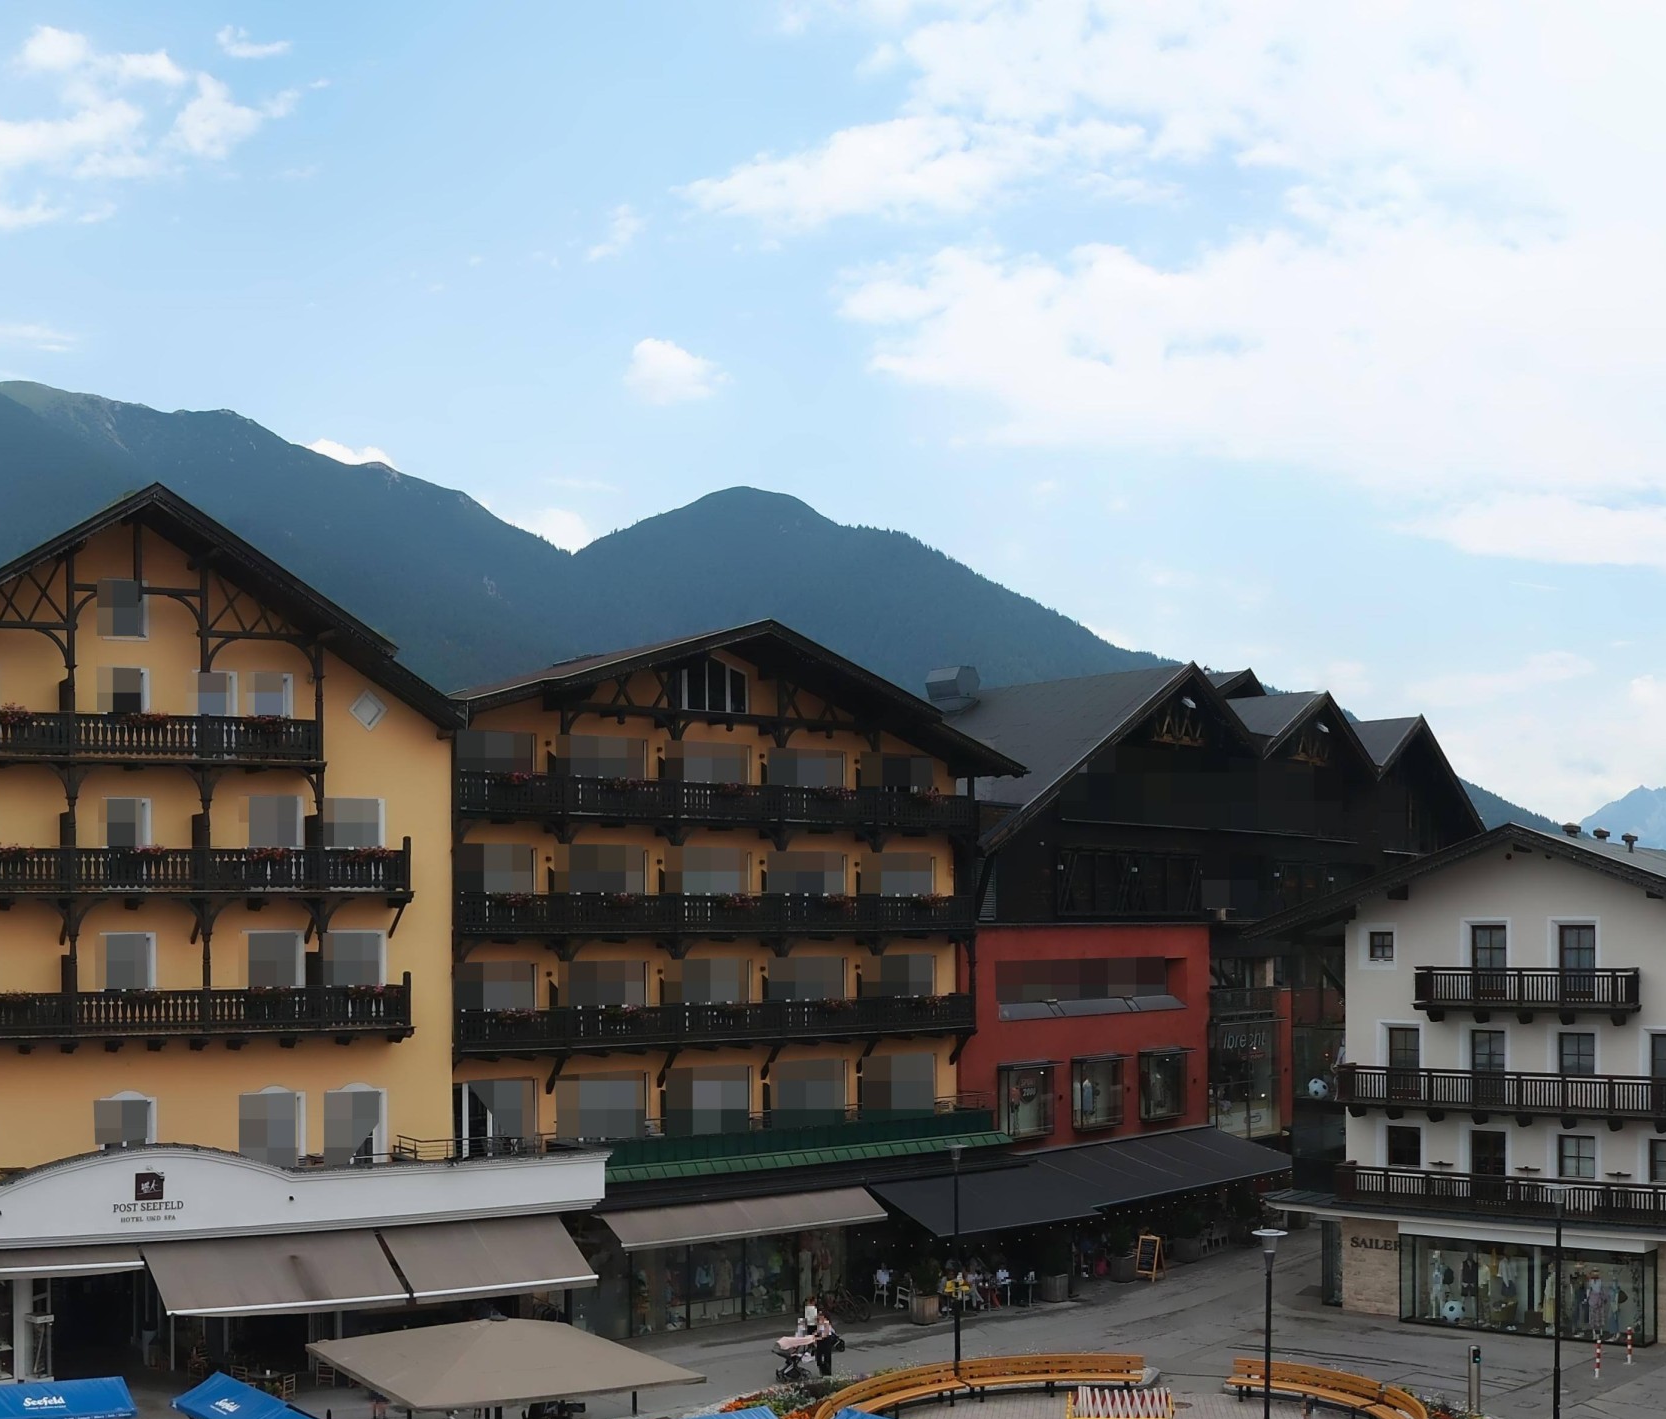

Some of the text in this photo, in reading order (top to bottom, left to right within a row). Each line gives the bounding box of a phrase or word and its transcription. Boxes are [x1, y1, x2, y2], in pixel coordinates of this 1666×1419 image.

[113, 1200, 184, 1213] POST SEEFELD
[23, 1395, 66, 1408] Seefeld
